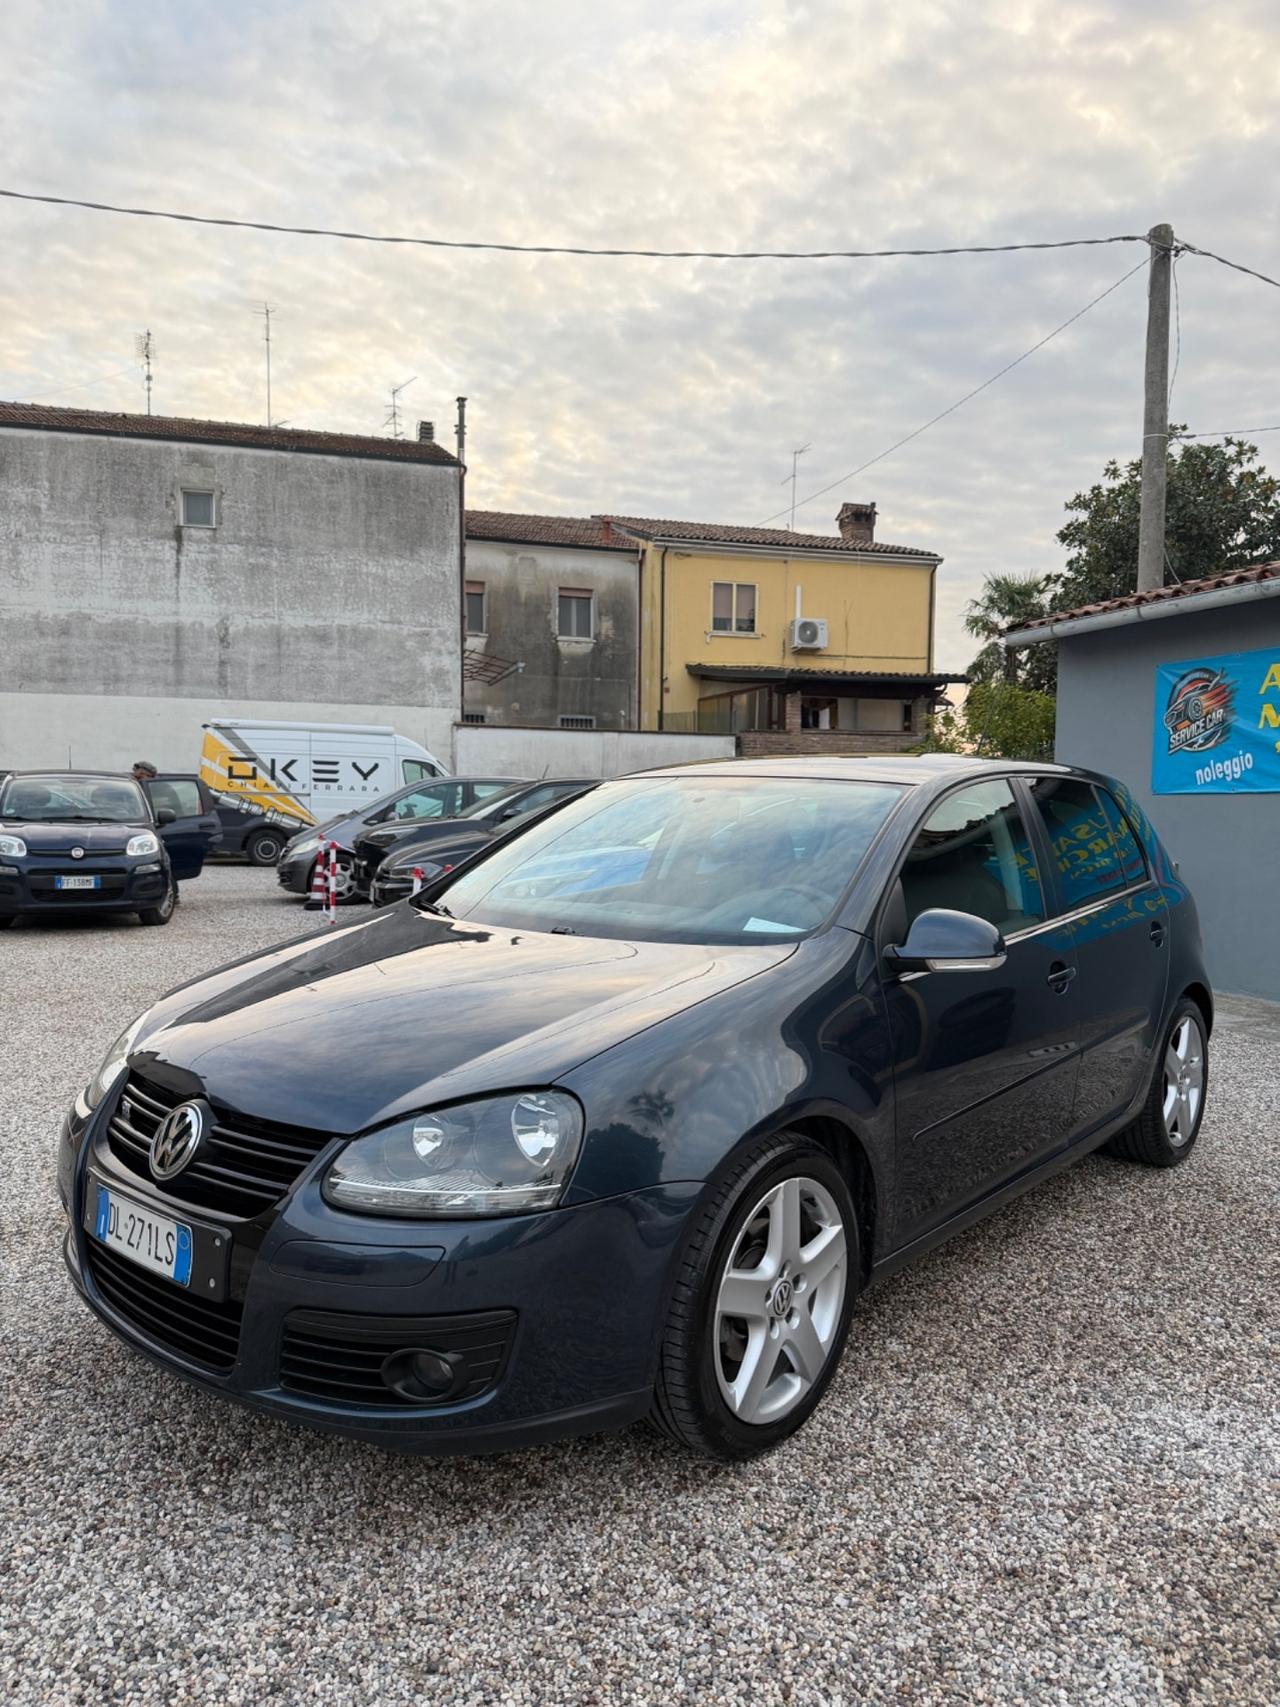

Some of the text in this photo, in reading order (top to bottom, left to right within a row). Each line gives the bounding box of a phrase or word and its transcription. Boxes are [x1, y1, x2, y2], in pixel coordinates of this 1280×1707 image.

[1169, 709, 1224, 749] SERVICE CAR
[1195, 750, 1253, 785] noleggio
[227, 781, 380, 793] CHIAVI FERRARA
